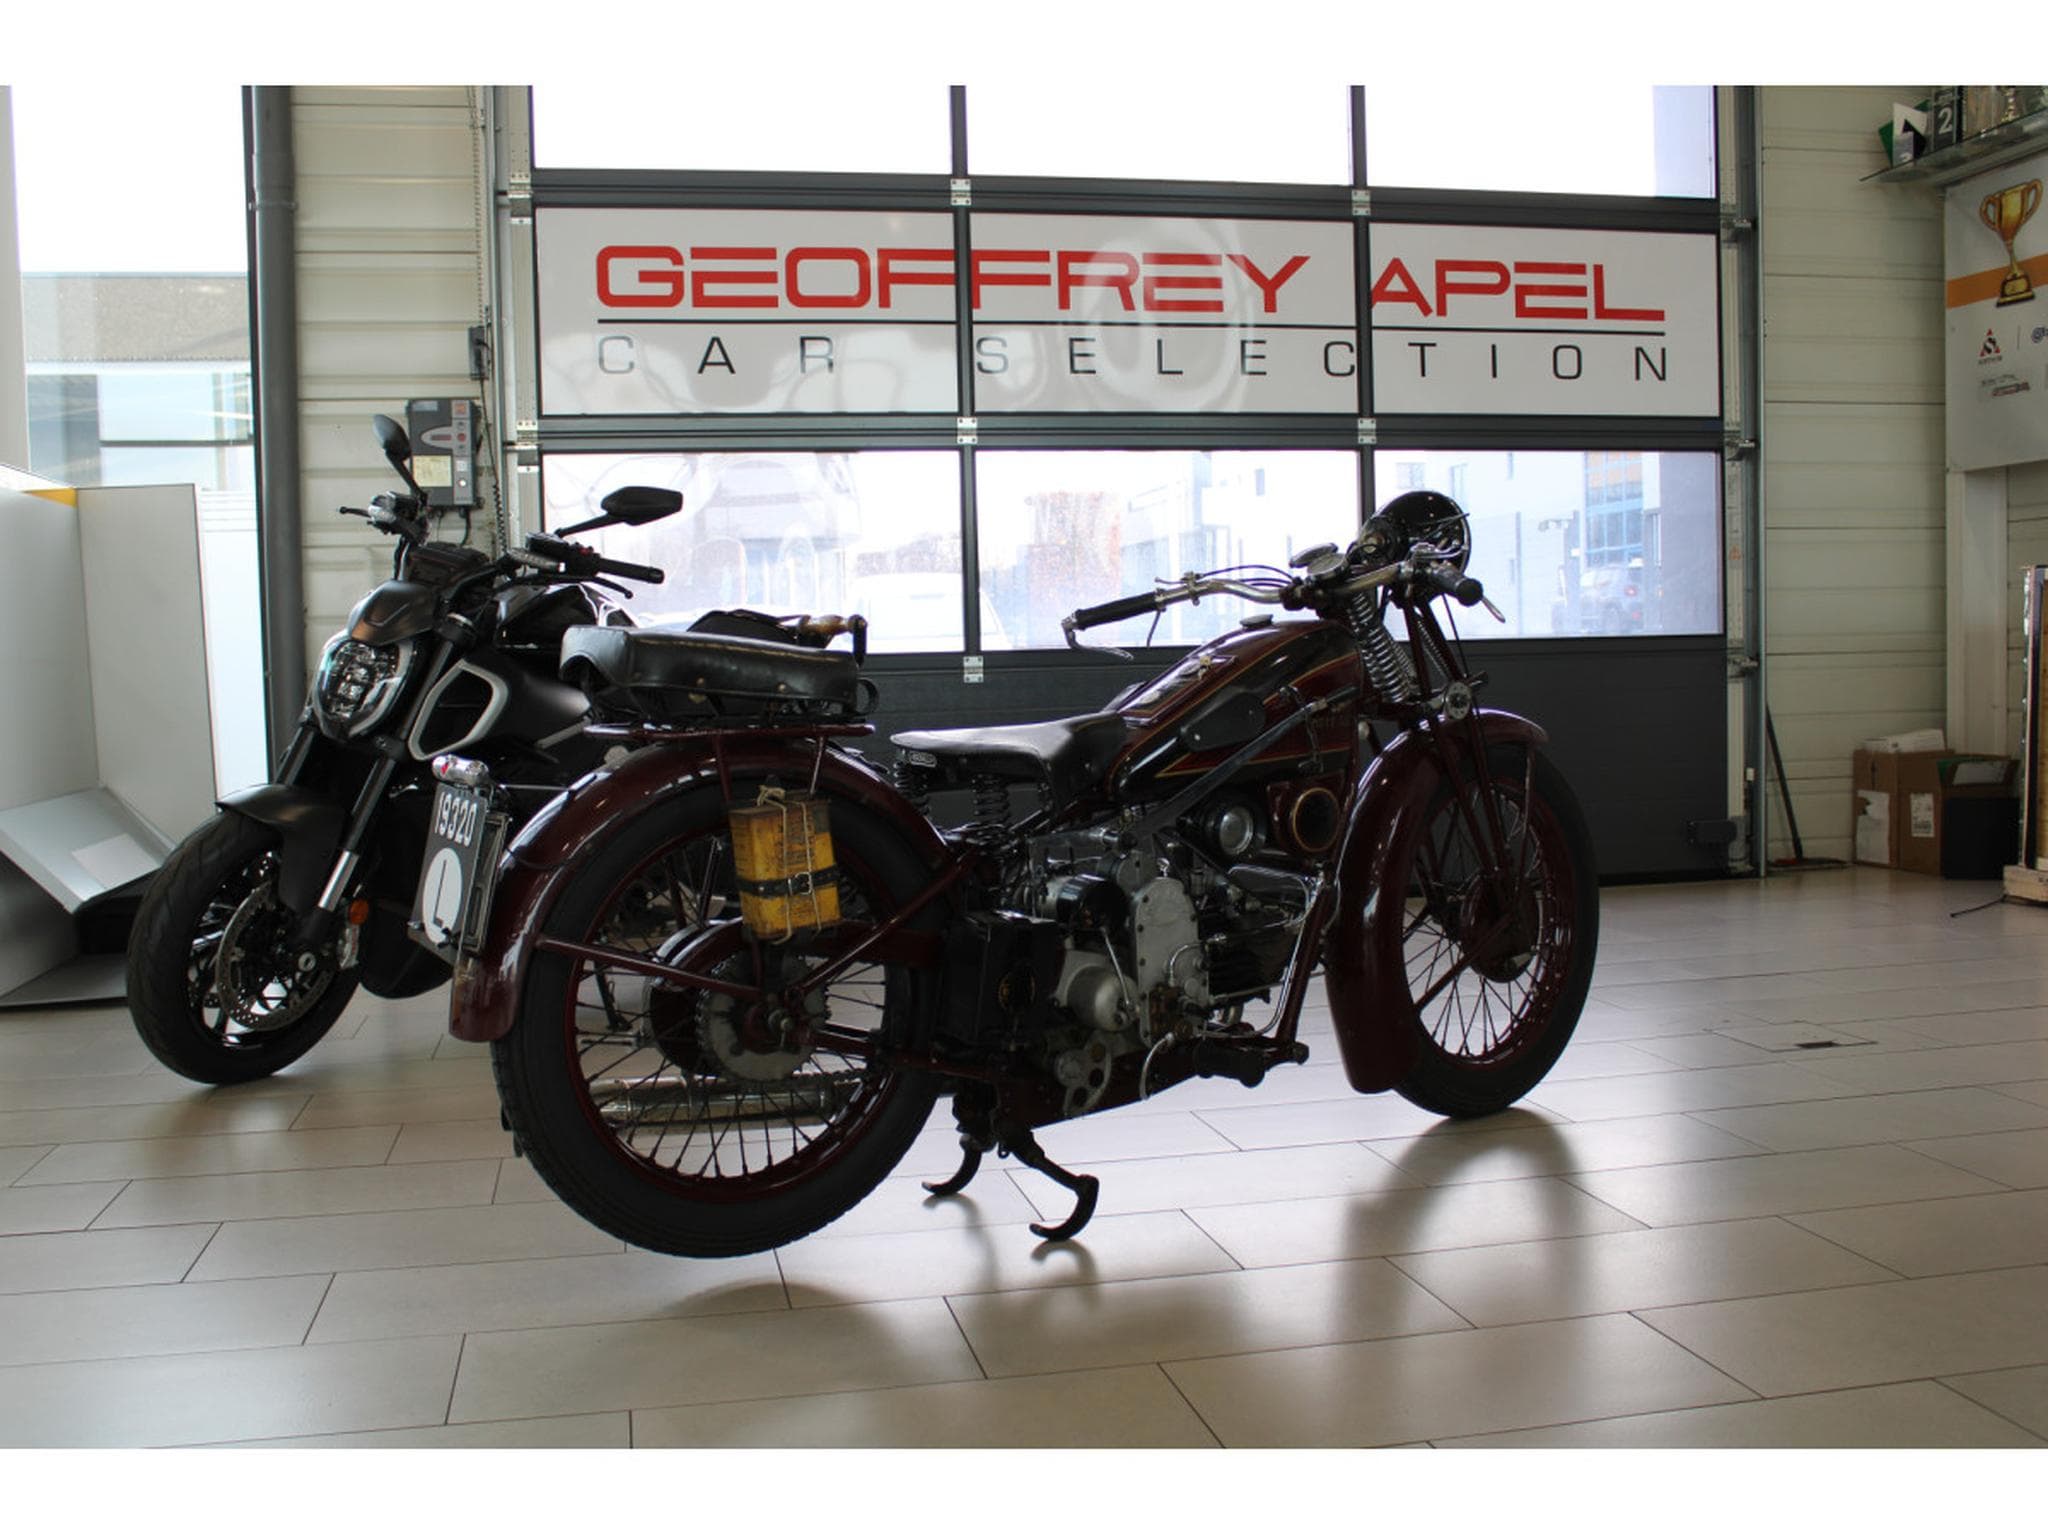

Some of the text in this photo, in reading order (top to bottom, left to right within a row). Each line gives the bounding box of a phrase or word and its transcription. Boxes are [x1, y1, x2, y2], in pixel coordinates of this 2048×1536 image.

[596, 245, 1666, 322] GEOFFREY APEL
[597, 335, 1668, 382] CAR SELECTION
[434, 791, 478, 848] 19320
